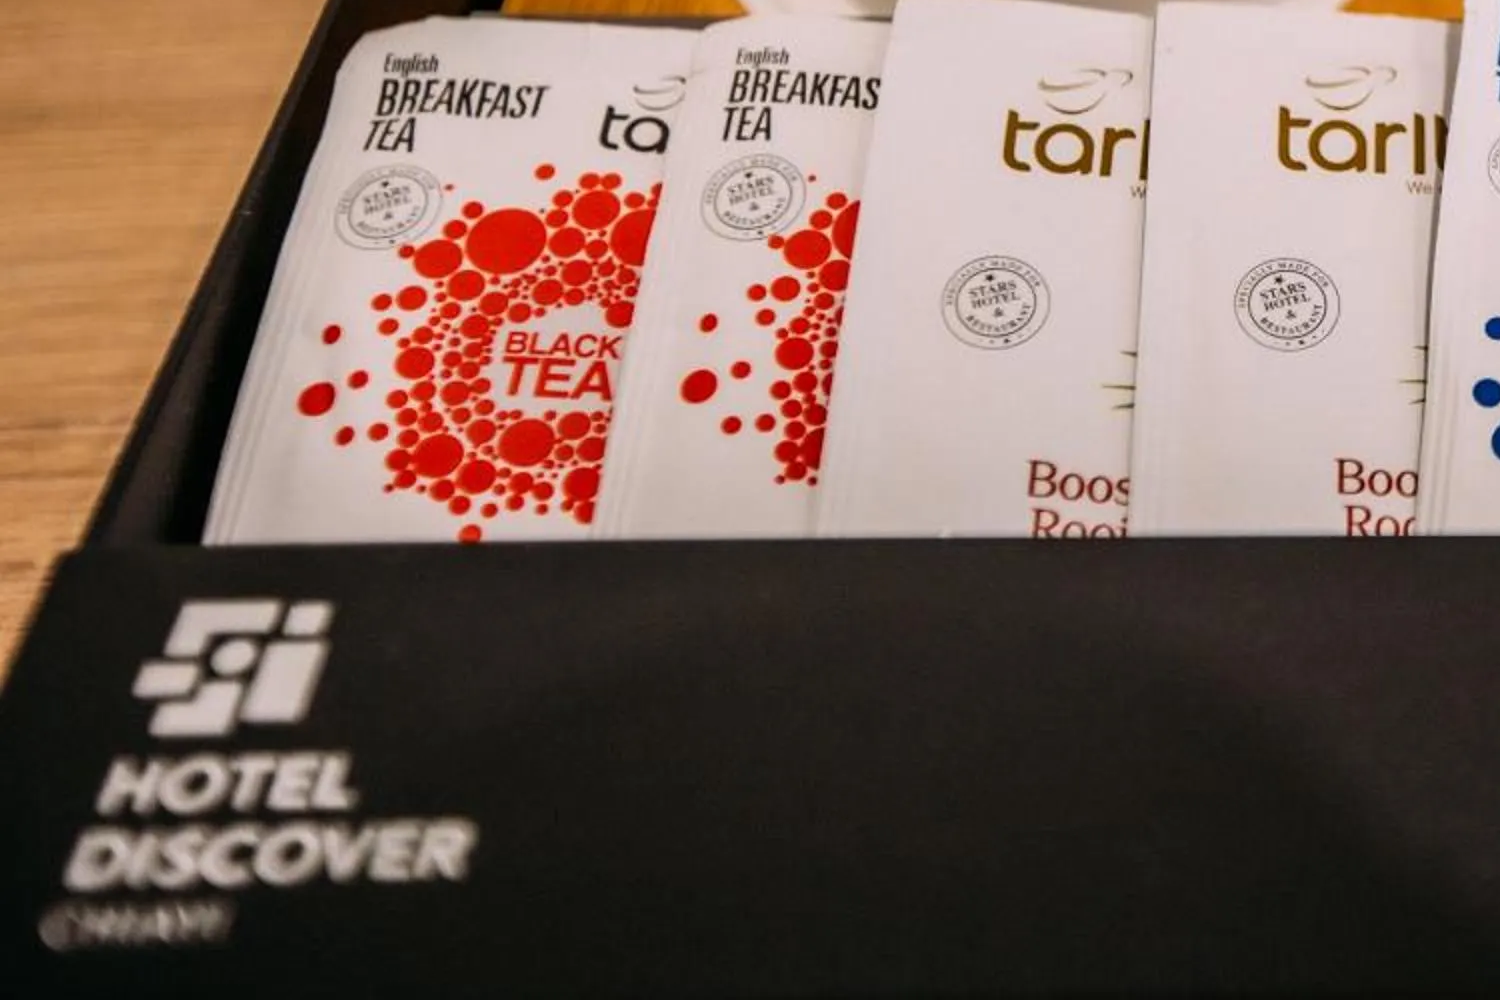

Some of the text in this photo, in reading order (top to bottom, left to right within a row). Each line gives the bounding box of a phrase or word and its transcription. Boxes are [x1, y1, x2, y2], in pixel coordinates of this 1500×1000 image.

[384, 52, 439, 77] English
[735, 46, 790, 67] English
[375, 78, 552, 119] BREAKFAST
[728, 69, 882, 111] BREAKFAS
[362, 116, 417, 153] TEA
[599, 104, 671, 155] ta
[721, 105, 772, 142] TEA
[968, 280, 1017, 298] STARS
[971, 291, 1021, 309] HOTEL
[1259, 282, 1307, 300] STARS
[1263, 293, 1312, 312] HOTEL
[1259, 303, 1323, 334] RESTAURANT
[504, 330, 623, 360] BLACK
[502, 355, 613, 402] TEA
[1027, 459, 1130, 507] Boos
[1334, 457, 1419, 499] Boo
[97, 752, 358, 815] HOTEL
[62, 818, 479, 892] DISCOVER
